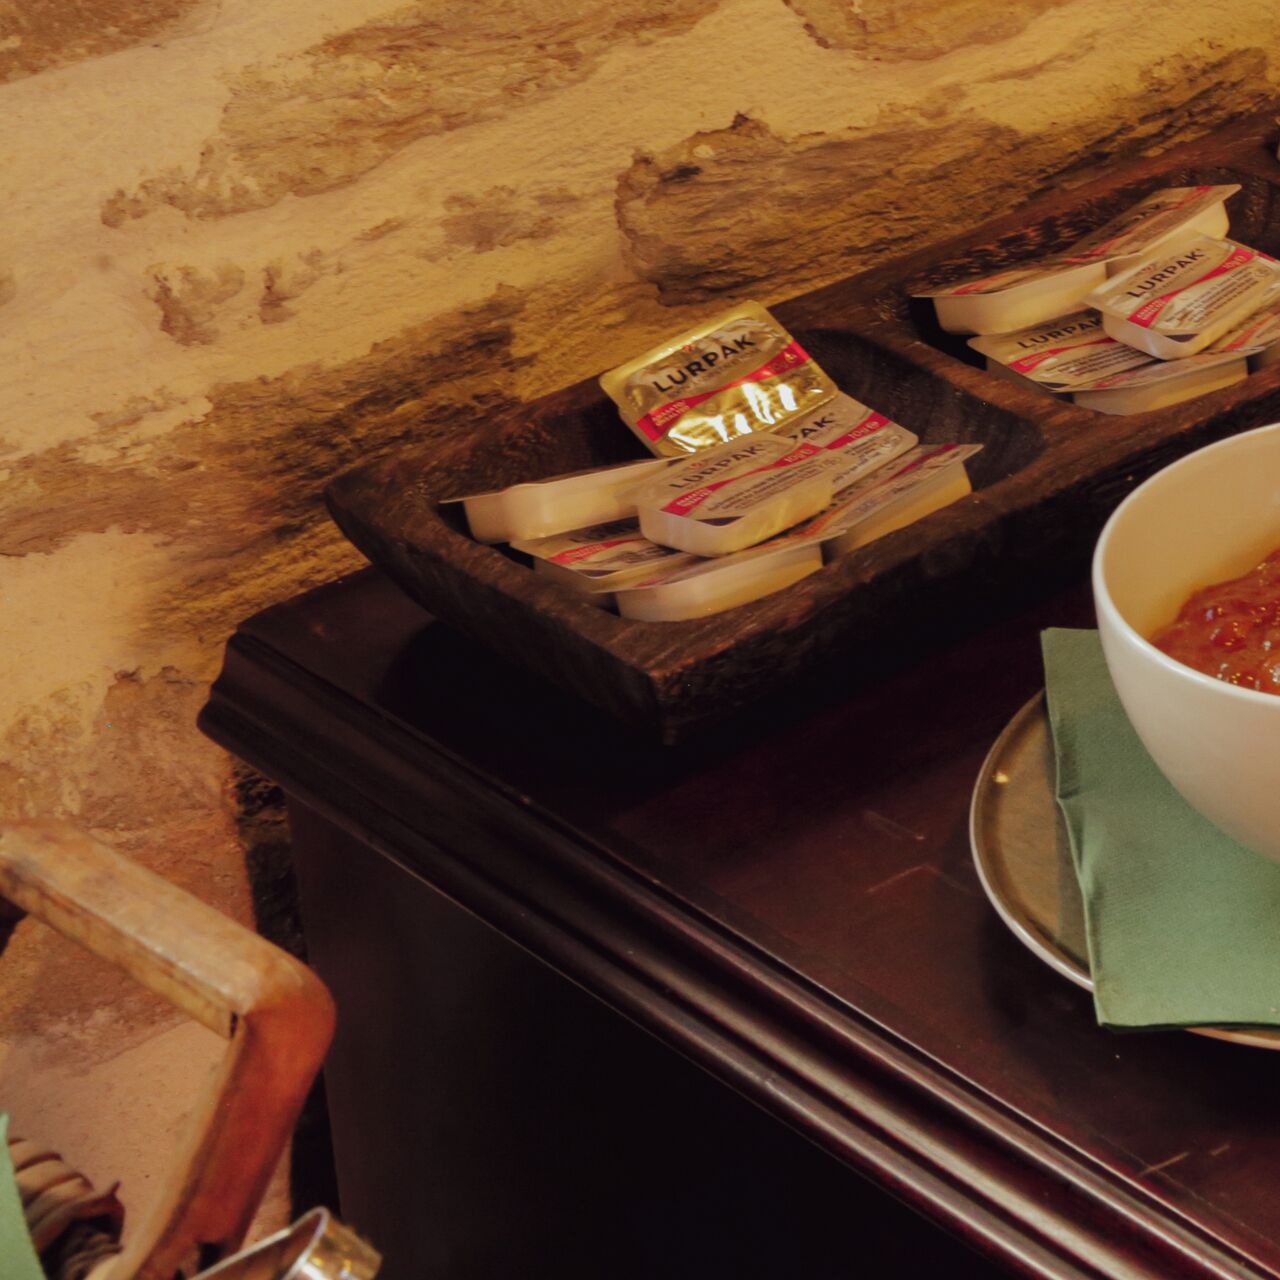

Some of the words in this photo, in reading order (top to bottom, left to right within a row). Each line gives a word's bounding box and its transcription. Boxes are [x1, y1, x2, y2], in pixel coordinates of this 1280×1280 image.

[1126, 250, 1206, 299] LURPAK
[653, 334, 756, 393] LURPAK
[669, 445, 763, 489] LURPAK
